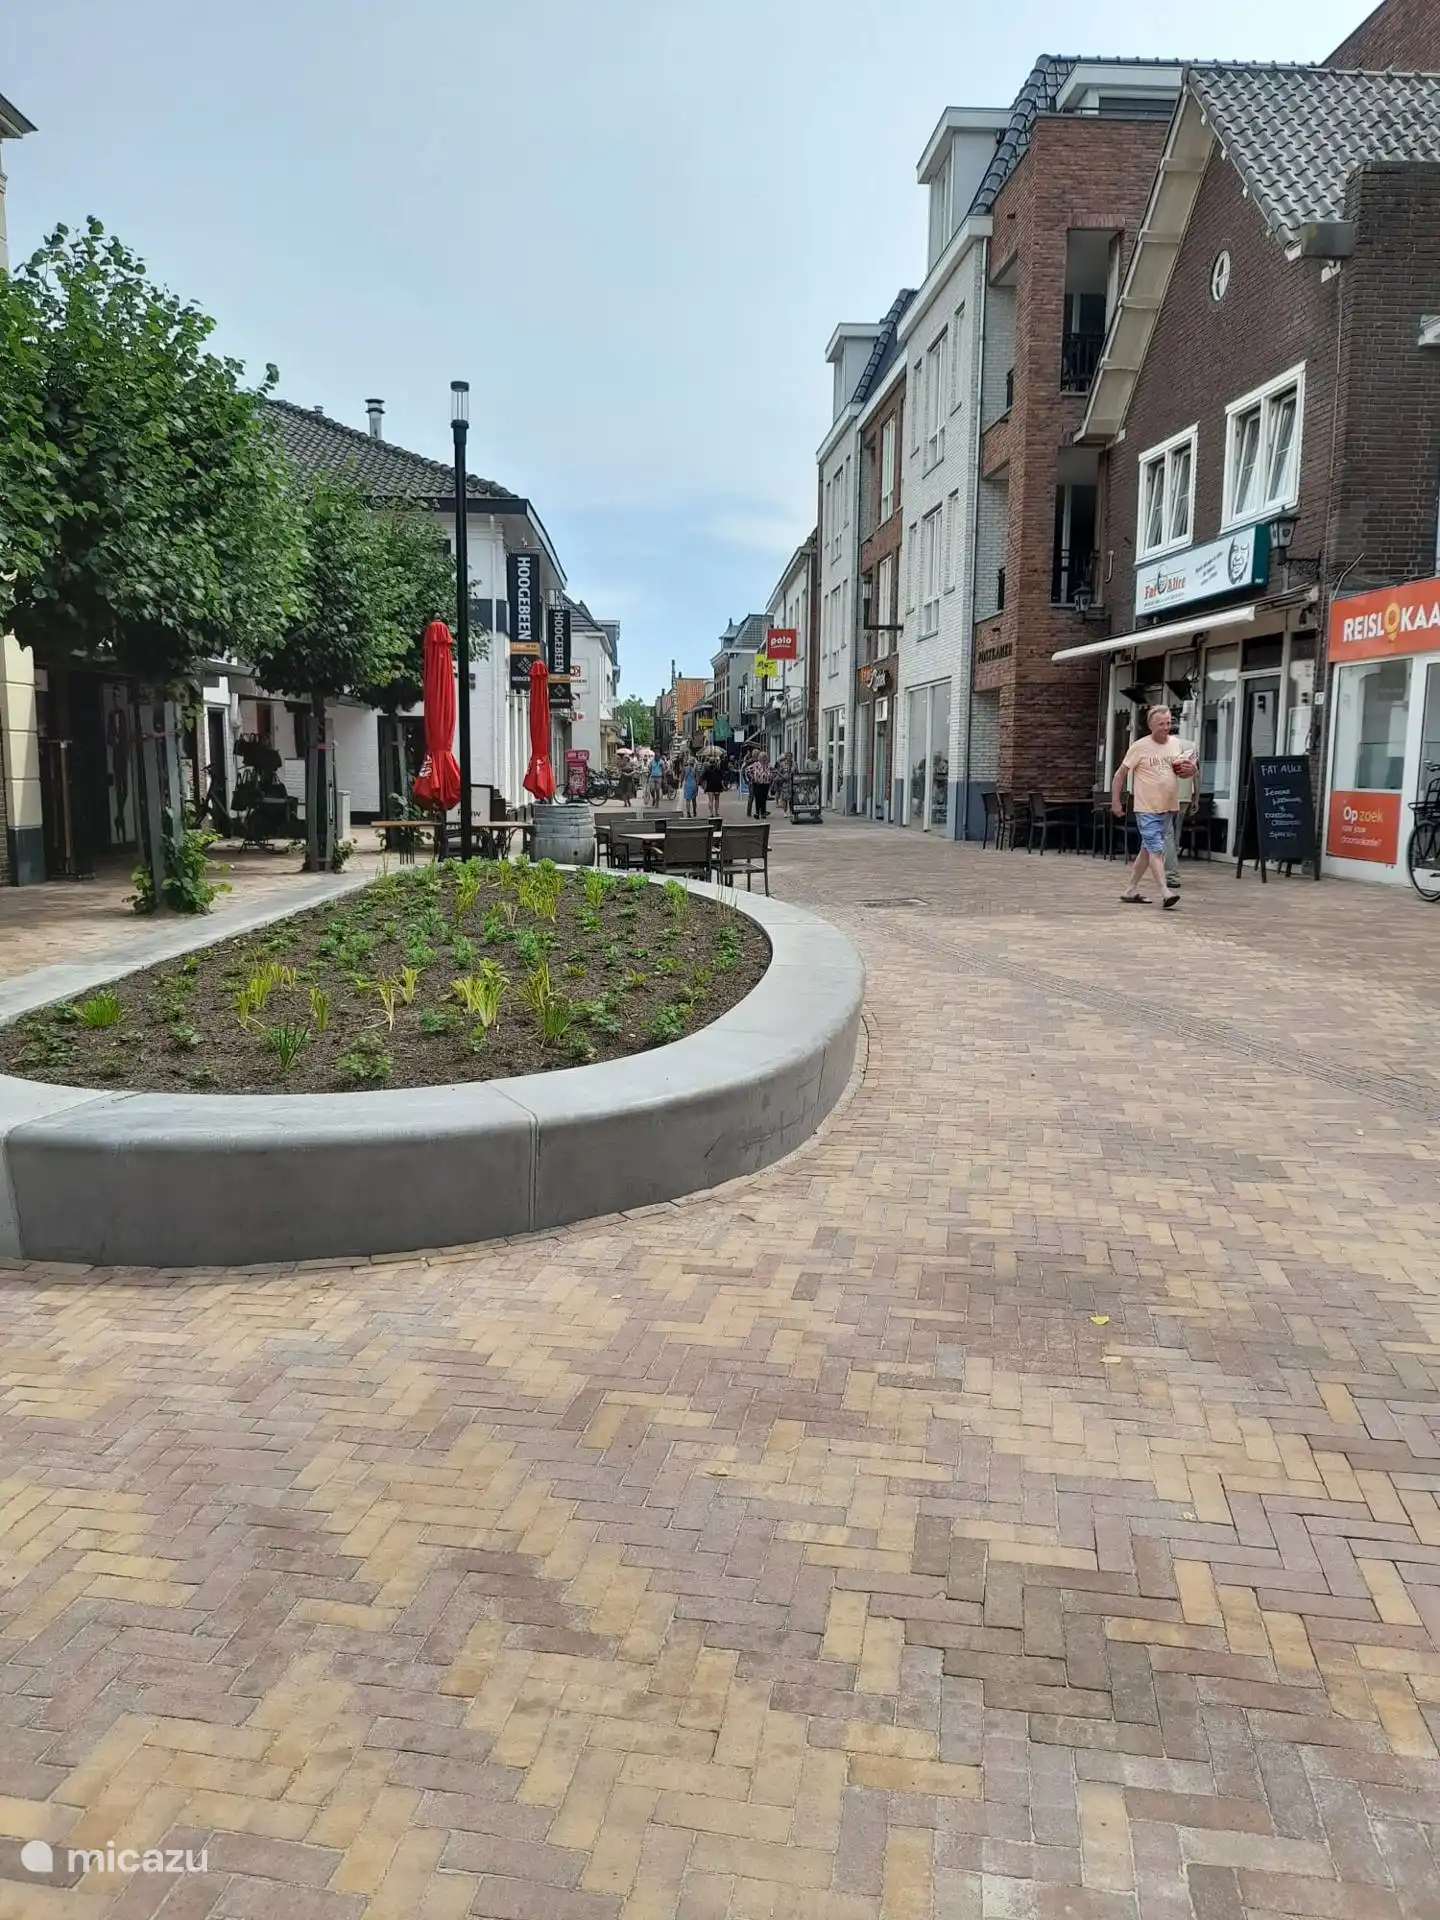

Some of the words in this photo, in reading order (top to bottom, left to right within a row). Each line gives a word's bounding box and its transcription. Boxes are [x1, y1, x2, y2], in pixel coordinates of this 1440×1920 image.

[517, 556, 531, 640] HOOGEBEEN
[554, 611, 565, 673] HOOGEBEEN
[770, 635, 792, 647] polo
[1261, 764, 1278, 776] FAT
[1343, 806, 1358, 824] Op
[1359, 808, 1384, 823] zoek
